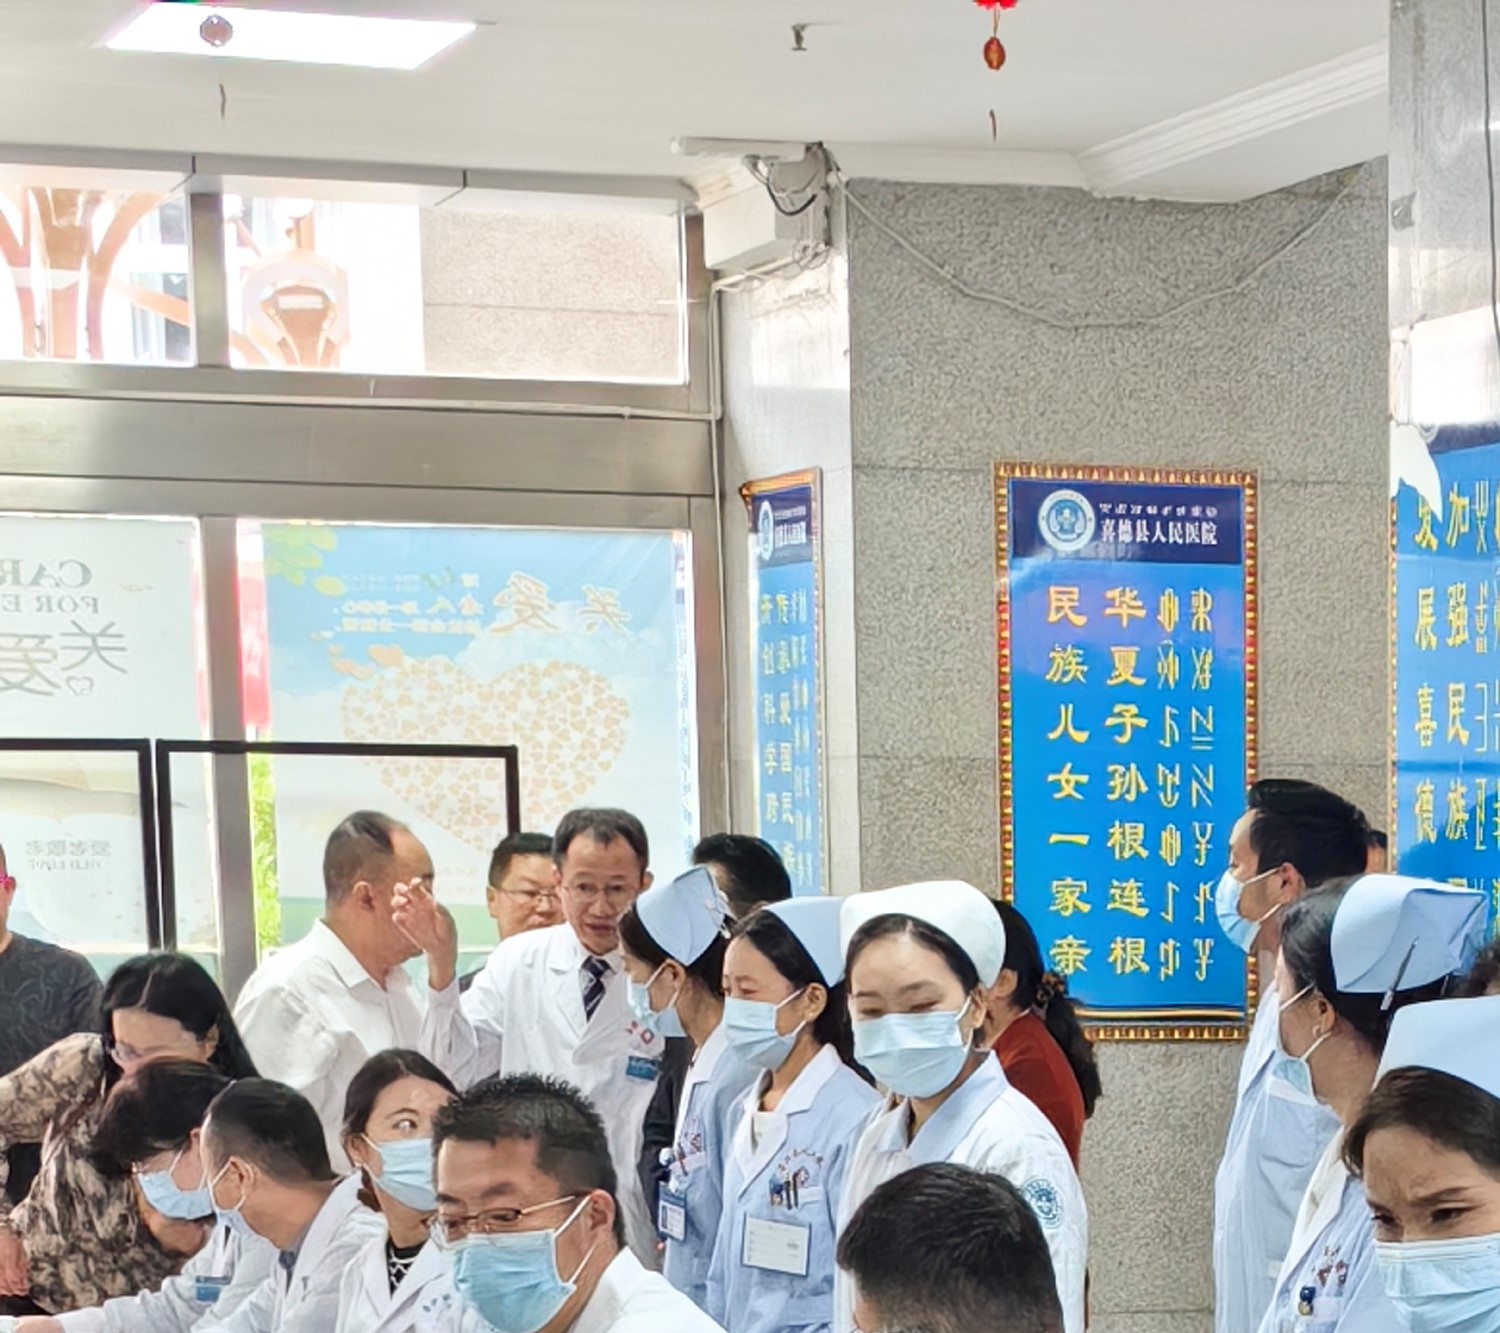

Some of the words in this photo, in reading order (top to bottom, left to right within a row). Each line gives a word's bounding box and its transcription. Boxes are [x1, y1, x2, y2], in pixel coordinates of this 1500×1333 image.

[1100, 519, 1218, 545] 喜德县人民医院
[1445, 481, 1470, 887] 加强民族
[1045, 585, 1092, 976] 民族儿女一家亲
[1104, 585, 1150, 975] 华夏子孙根连根
